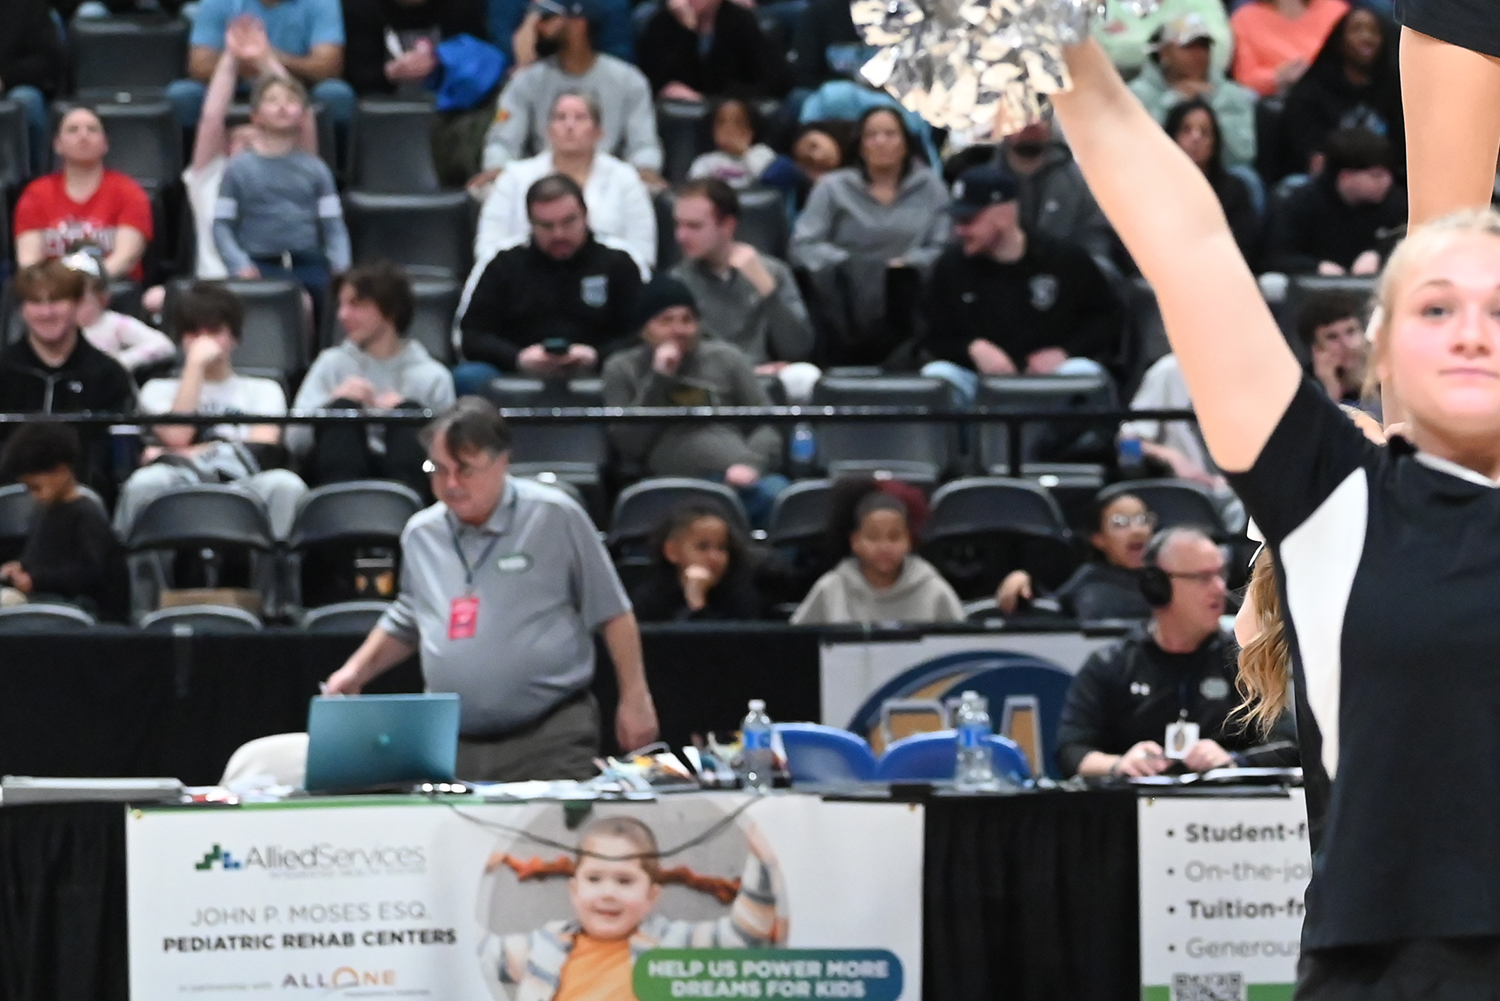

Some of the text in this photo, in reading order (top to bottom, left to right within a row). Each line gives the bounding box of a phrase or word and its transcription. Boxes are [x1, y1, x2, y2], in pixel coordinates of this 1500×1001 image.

[245, 844, 427, 871] AlliedServices
[191, 906, 257, 927] JOHN
[289, 902, 371, 923] MOSES
[163, 927, 457, 952] PEDIATRIC REHAB CENTERS
[648, 958, 889, 978] HELP US POWER MORE
[671, 979, 866, 998] DREAMS FOR KIDS
